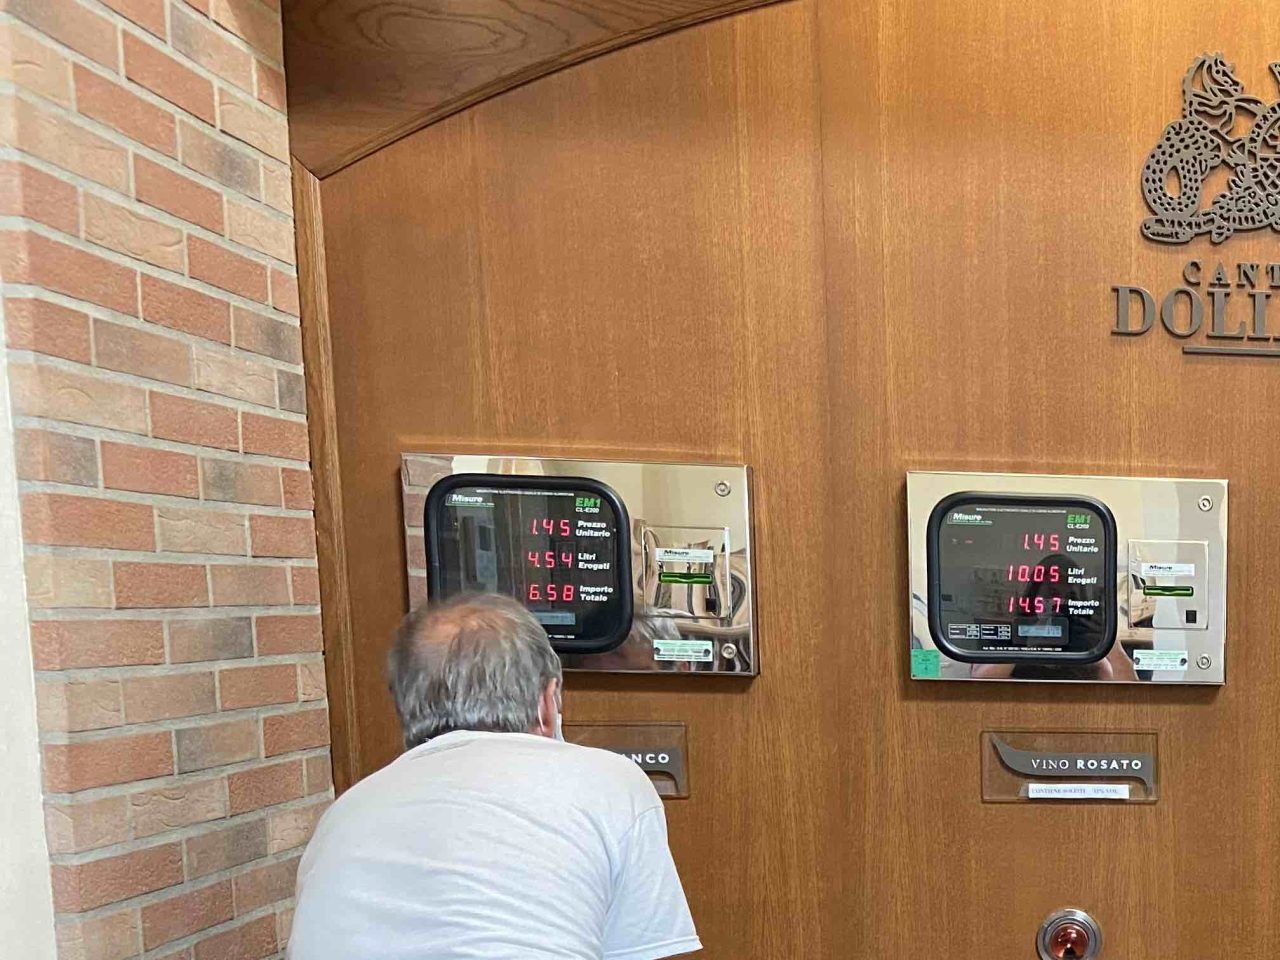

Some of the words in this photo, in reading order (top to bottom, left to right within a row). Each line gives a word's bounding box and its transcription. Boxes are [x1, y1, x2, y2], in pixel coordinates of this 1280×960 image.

[575, 498, 600, 507] EM1
[1067, 514, 1091, 523] EM1
[531, 519, 570, 536] 1.45
[577, 521, 606, 529] Prezzo
[576, 529, 610, 538] Unitario
[1024, 534, 1060, 550] 1.45
[1066, 545, 1099, 553] Unitario
[528, 552, 573, 568] 4.54
[578, 553, 596, 561] Litri
[578, 562, 610, 571] Erogati
[1007, 565, 1060, 583] 10.05
[1068, 576, 1097, 585] Erogati
[528, 584, 574, 600] 6.58
[580, 585, 614, 595] Importo
[580, 594, 608, 602] Totale
[1008, 597, 1061, 613] 14.57
[1068, 599, 1100, 608] Importo
[623, 753, 669, 763] NCO
[1031, 759, 1070, 770] VINO
[1077, 759, 1142, 770] ROSATO
